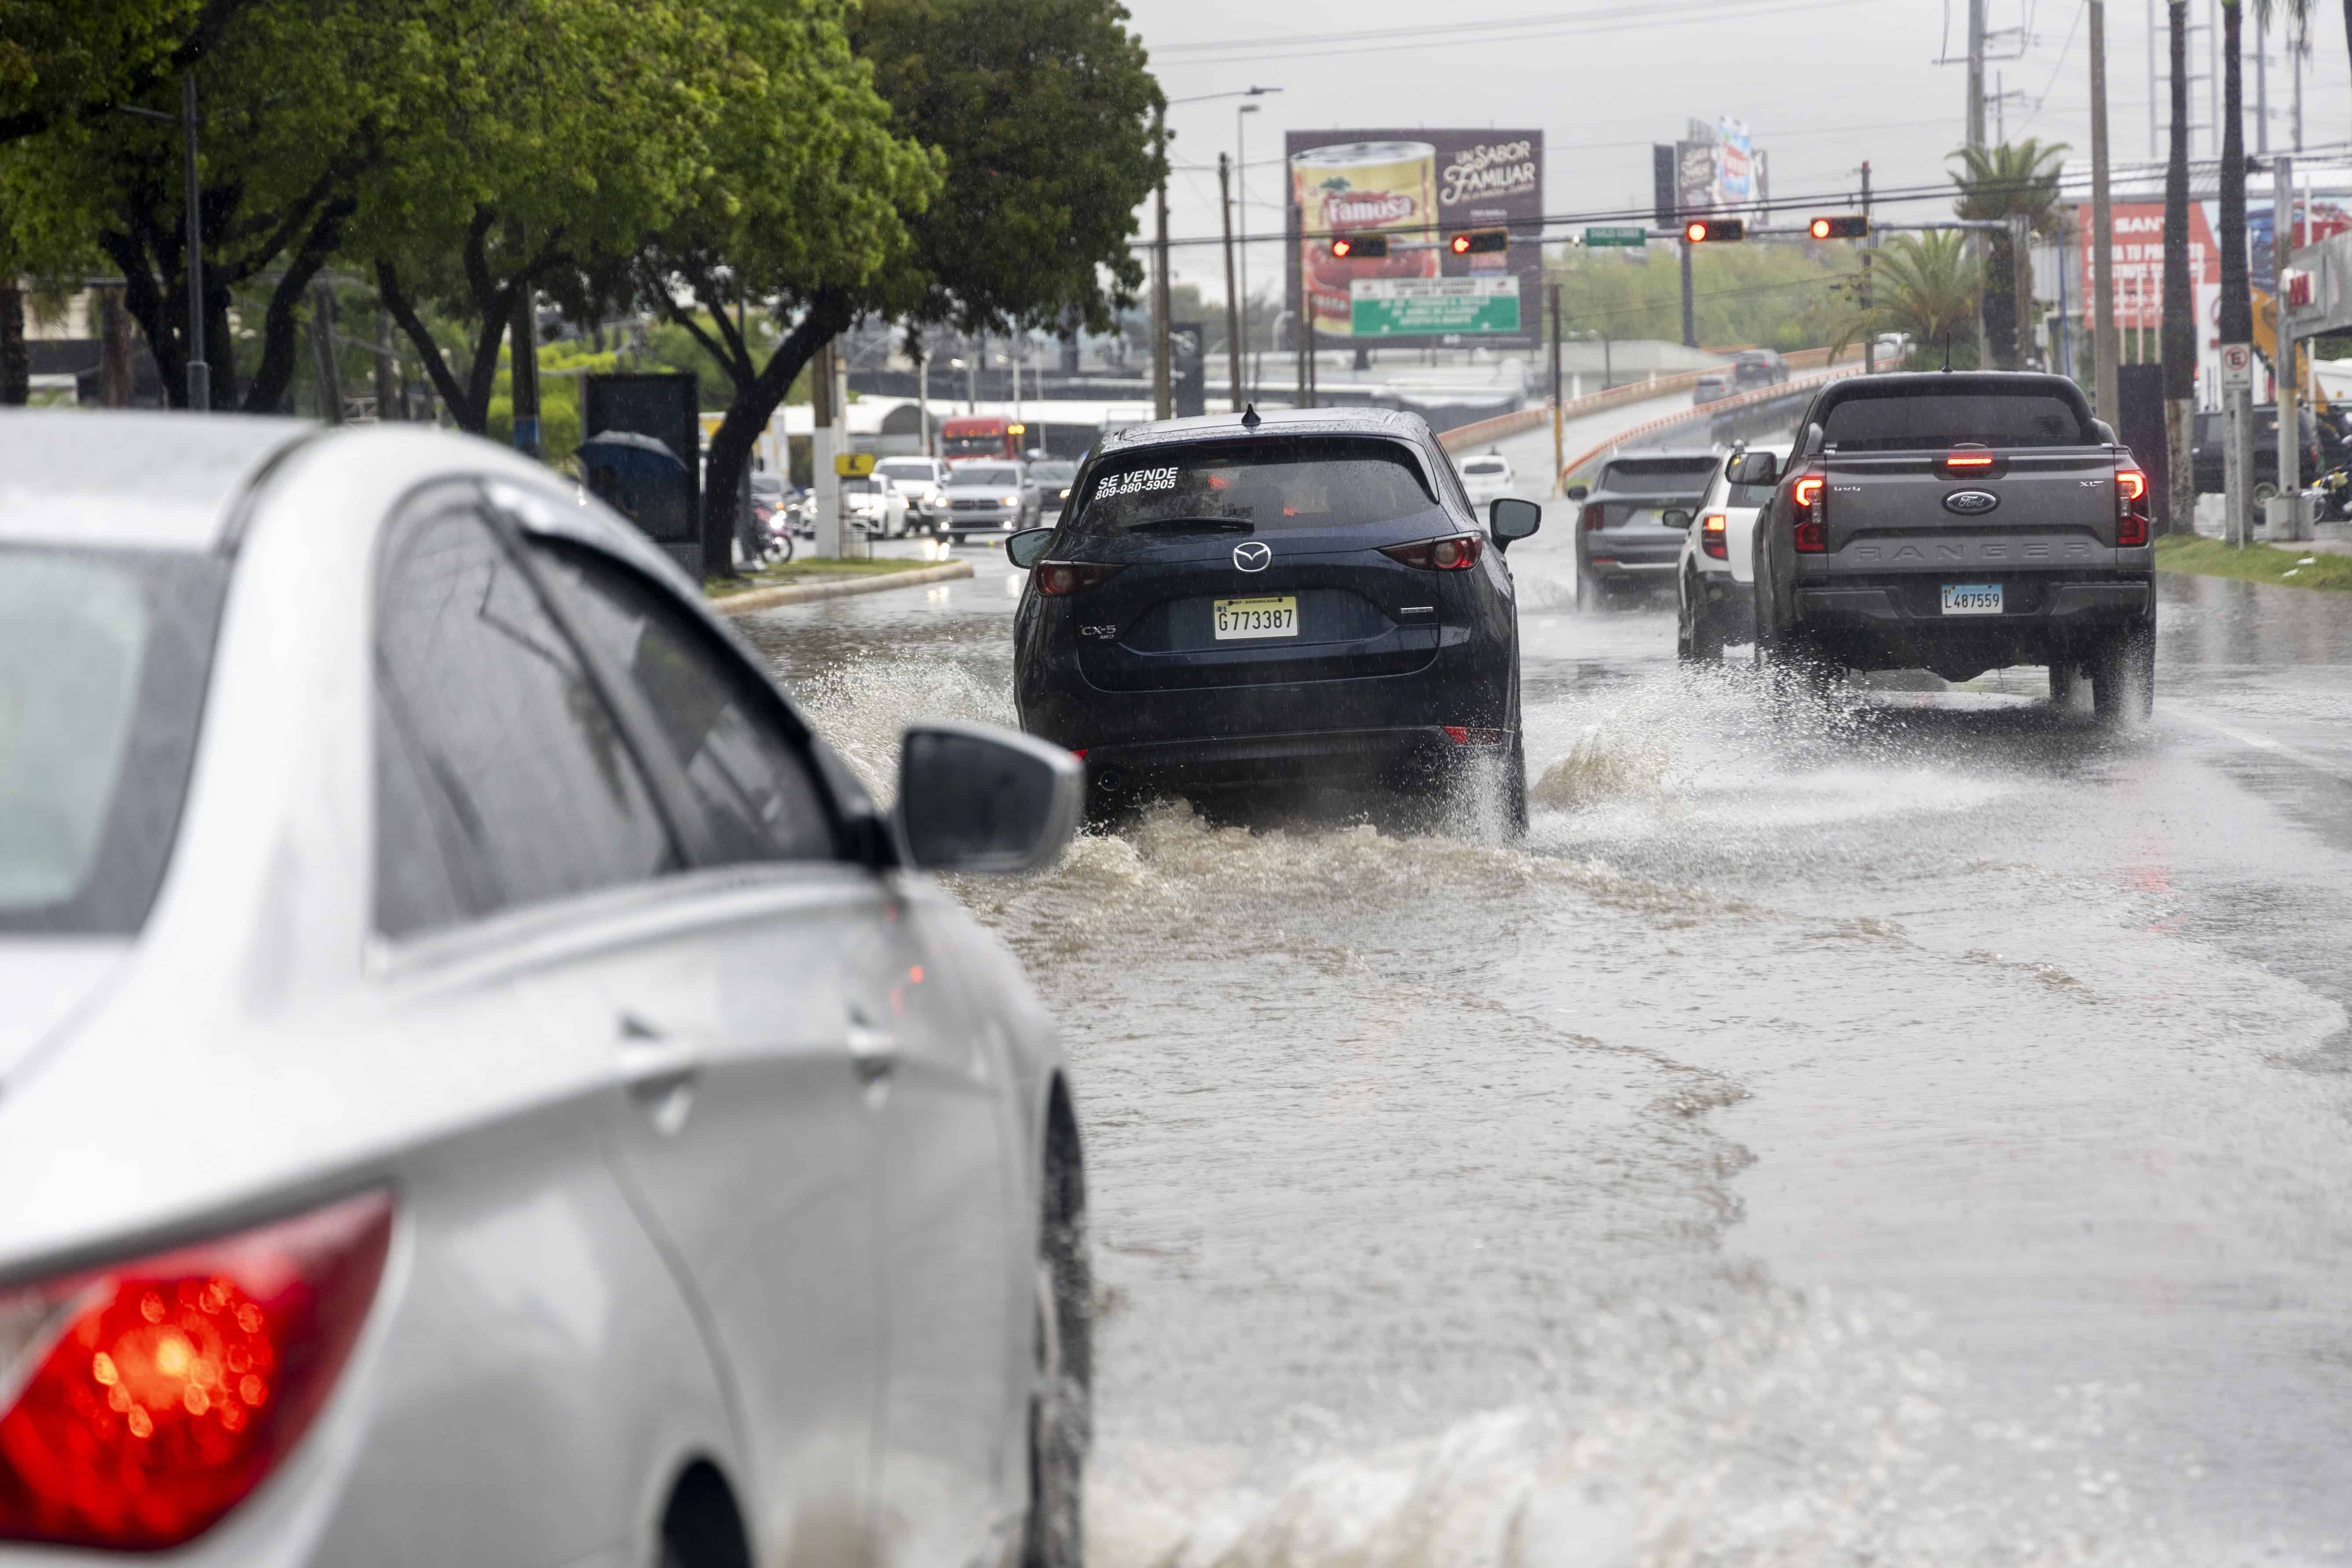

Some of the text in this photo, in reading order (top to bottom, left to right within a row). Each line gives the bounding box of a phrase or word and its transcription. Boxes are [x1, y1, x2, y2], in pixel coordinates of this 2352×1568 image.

[1455, 140, 1531, 171] UN SABOR
[1440, 161, 1535, 205] FAMILIAR
[1329, 197, 1412, 222] Famosa
[1098, 467, 1179, 489] SE VENDE
[1095, 479, 1176, 500] 809-980-5905
[1958, 496, 1985, 507] Ford
[1854, 541, 2090, 562] RANGER
[1945, 594, 2000, 609] L487559
[1082, 625, 1116, 635] CX-5
[1219, 609, 1293, 631] G773387
